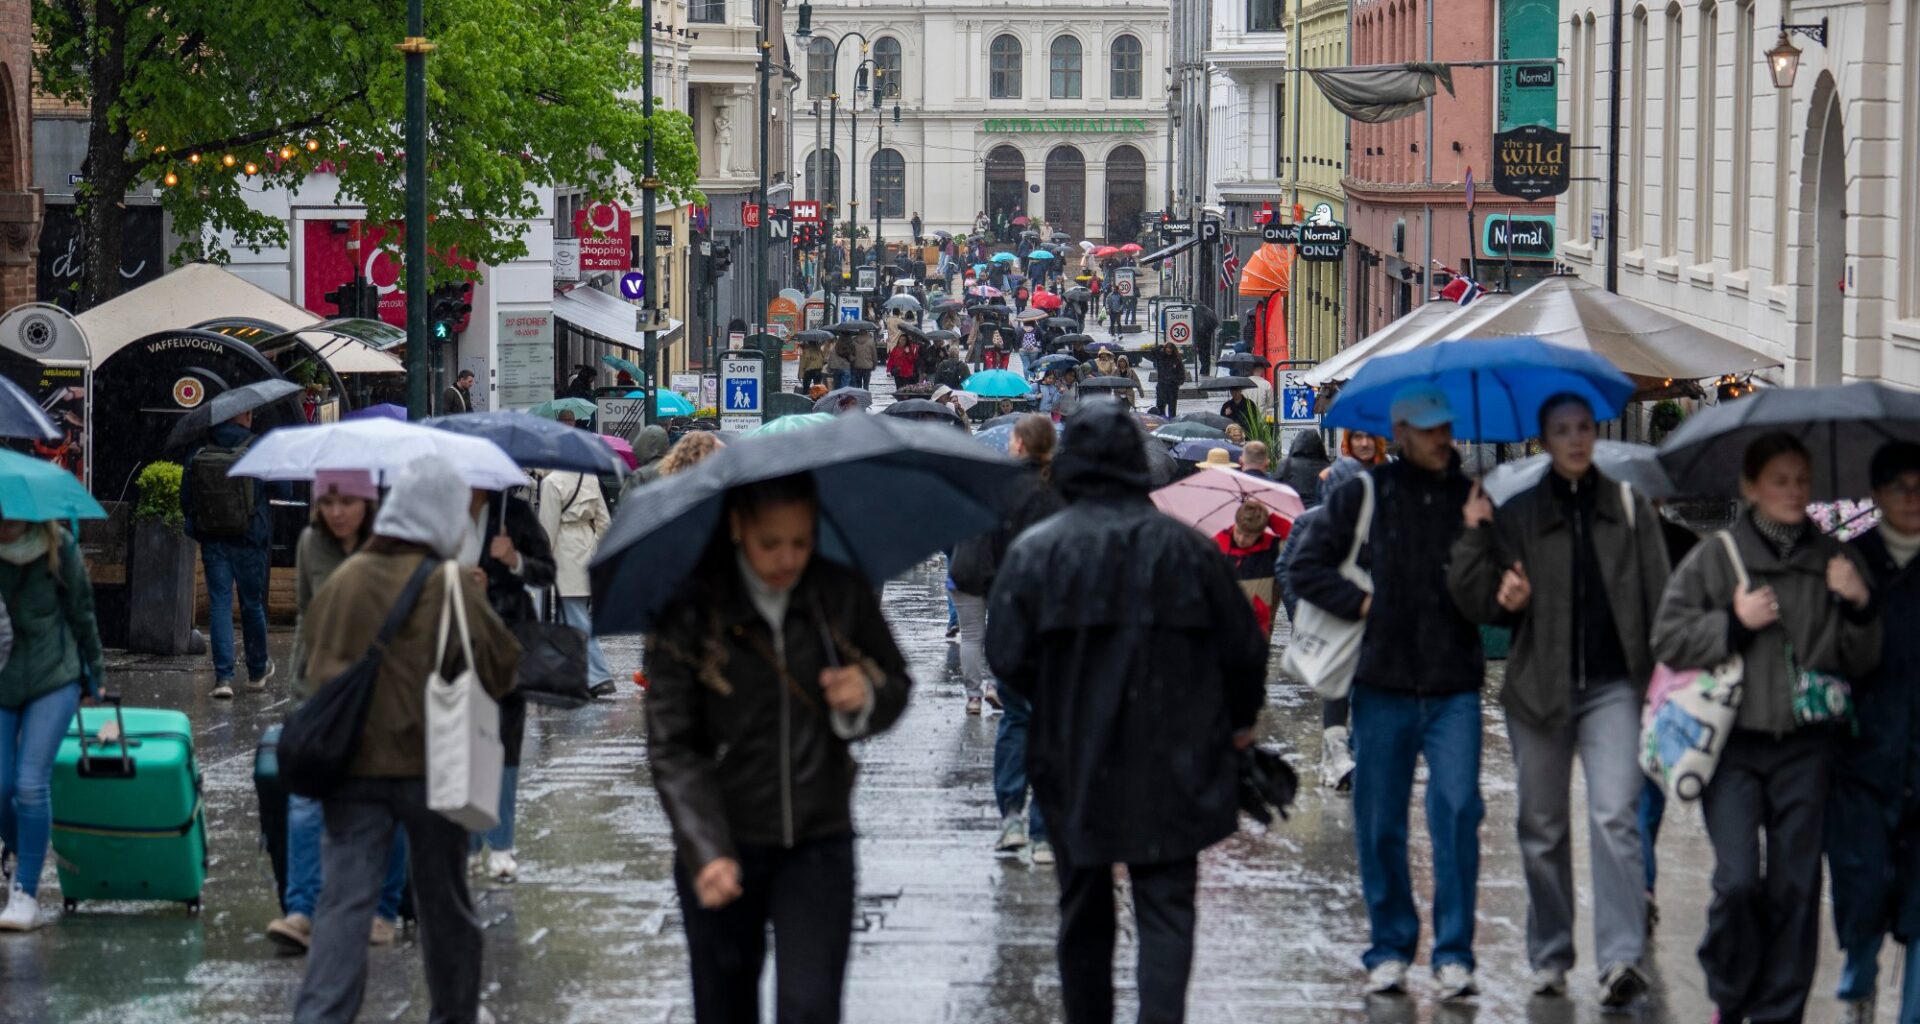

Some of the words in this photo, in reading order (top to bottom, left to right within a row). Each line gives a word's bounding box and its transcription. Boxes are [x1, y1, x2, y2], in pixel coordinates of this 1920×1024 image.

[1520, 71, 1551, 83] Normal
[984, 118, 1147, 133] ØSTBANEHALLEN
[794, 205, 816, 218] HH
[770, 220, 788, 238] N
[1304, 229, 1340, 241] Normal
[580, 245, 626, 257] shopping
[1302, 245, 1340, 256] ONLY
[585, 258, 593, 266] 10
[1119, 283, 1130, 292] 30
[1170, 312, 1188, 320] Sone
[1173, 327, 1187, 337] 30
[147, 338, 223, 353] VAFFELVOGNA
[728, 363, 756, 373] Sone
[731, 379, 753, 387] Gågate
[605, 402, 638, 415] Sone
